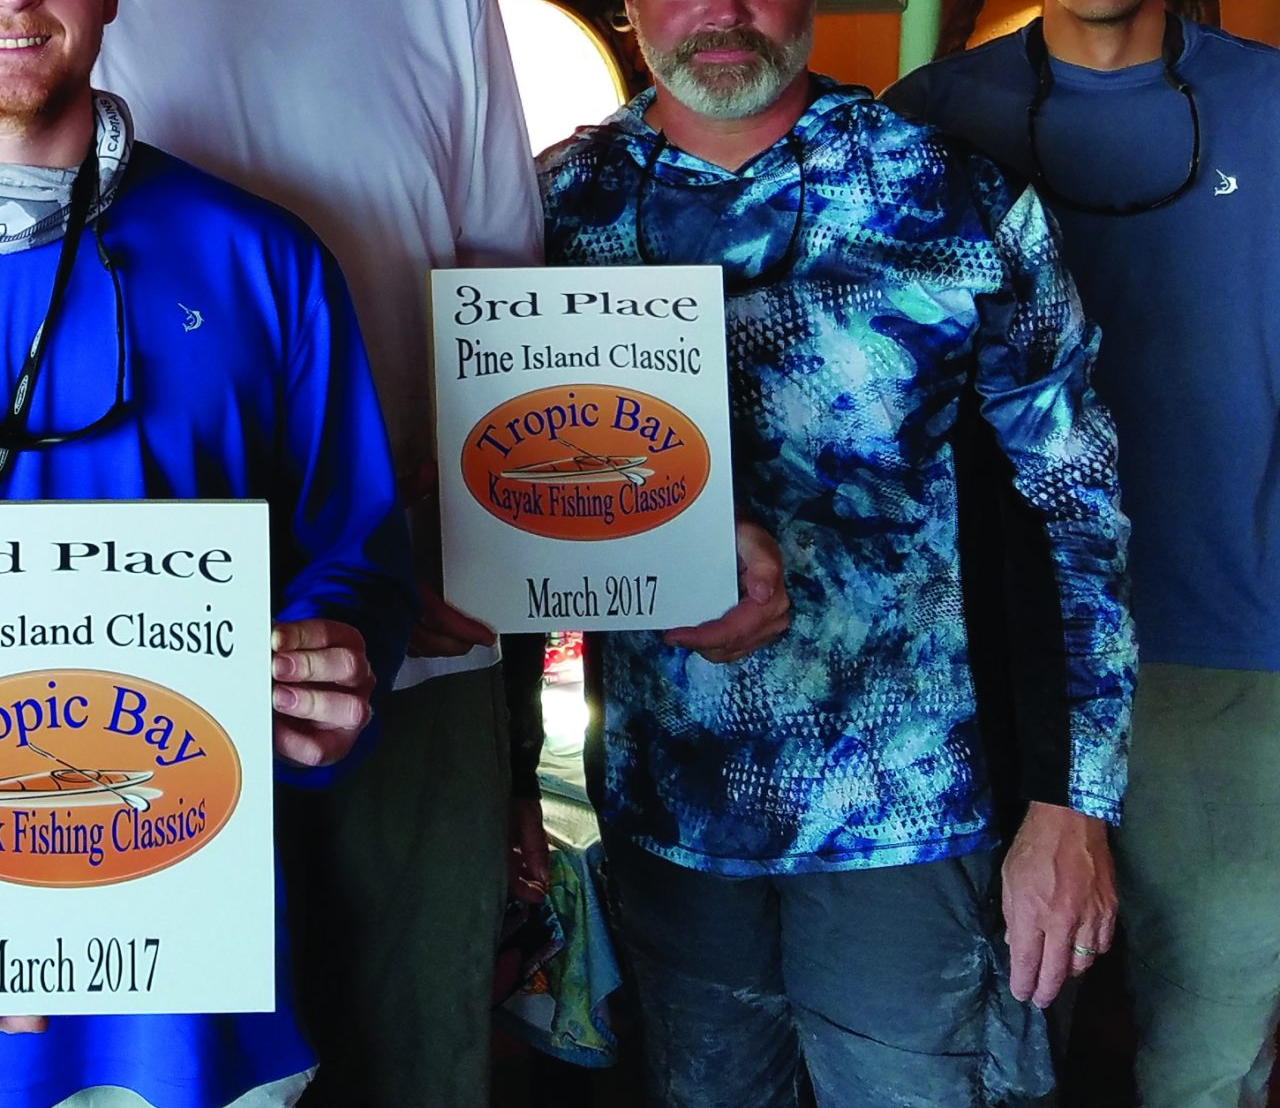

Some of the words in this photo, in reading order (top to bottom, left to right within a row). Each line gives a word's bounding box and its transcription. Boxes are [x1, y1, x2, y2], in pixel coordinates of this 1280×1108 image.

[454, 285, 542, 326] 3rd
[561, 291, 699, 322] Place
[455, 337, 513, 380] Pine
[520, 345, 600, 371] Island
[609, 336, 701, 375] Classic
[476, 392, 599, 459] Tropic
[610, 395, 685, 454] Bay
[487, 470, 543, 521] Kayak
[549, 486, 614, 525] Fishing
[619, 475, 686, 516] Classics
[52, 541, 233, 583] Place
[526, 576, 600, 619] March
[605, 576, 658, 617] 2017
[106, 604, 234, 658] Classic
[103, 685, 207, 767] Bay
[12, 810, 104, 867] Fishing
[111, 797, 206, 853] Classics
[86, 937, 160, 993] 2017
